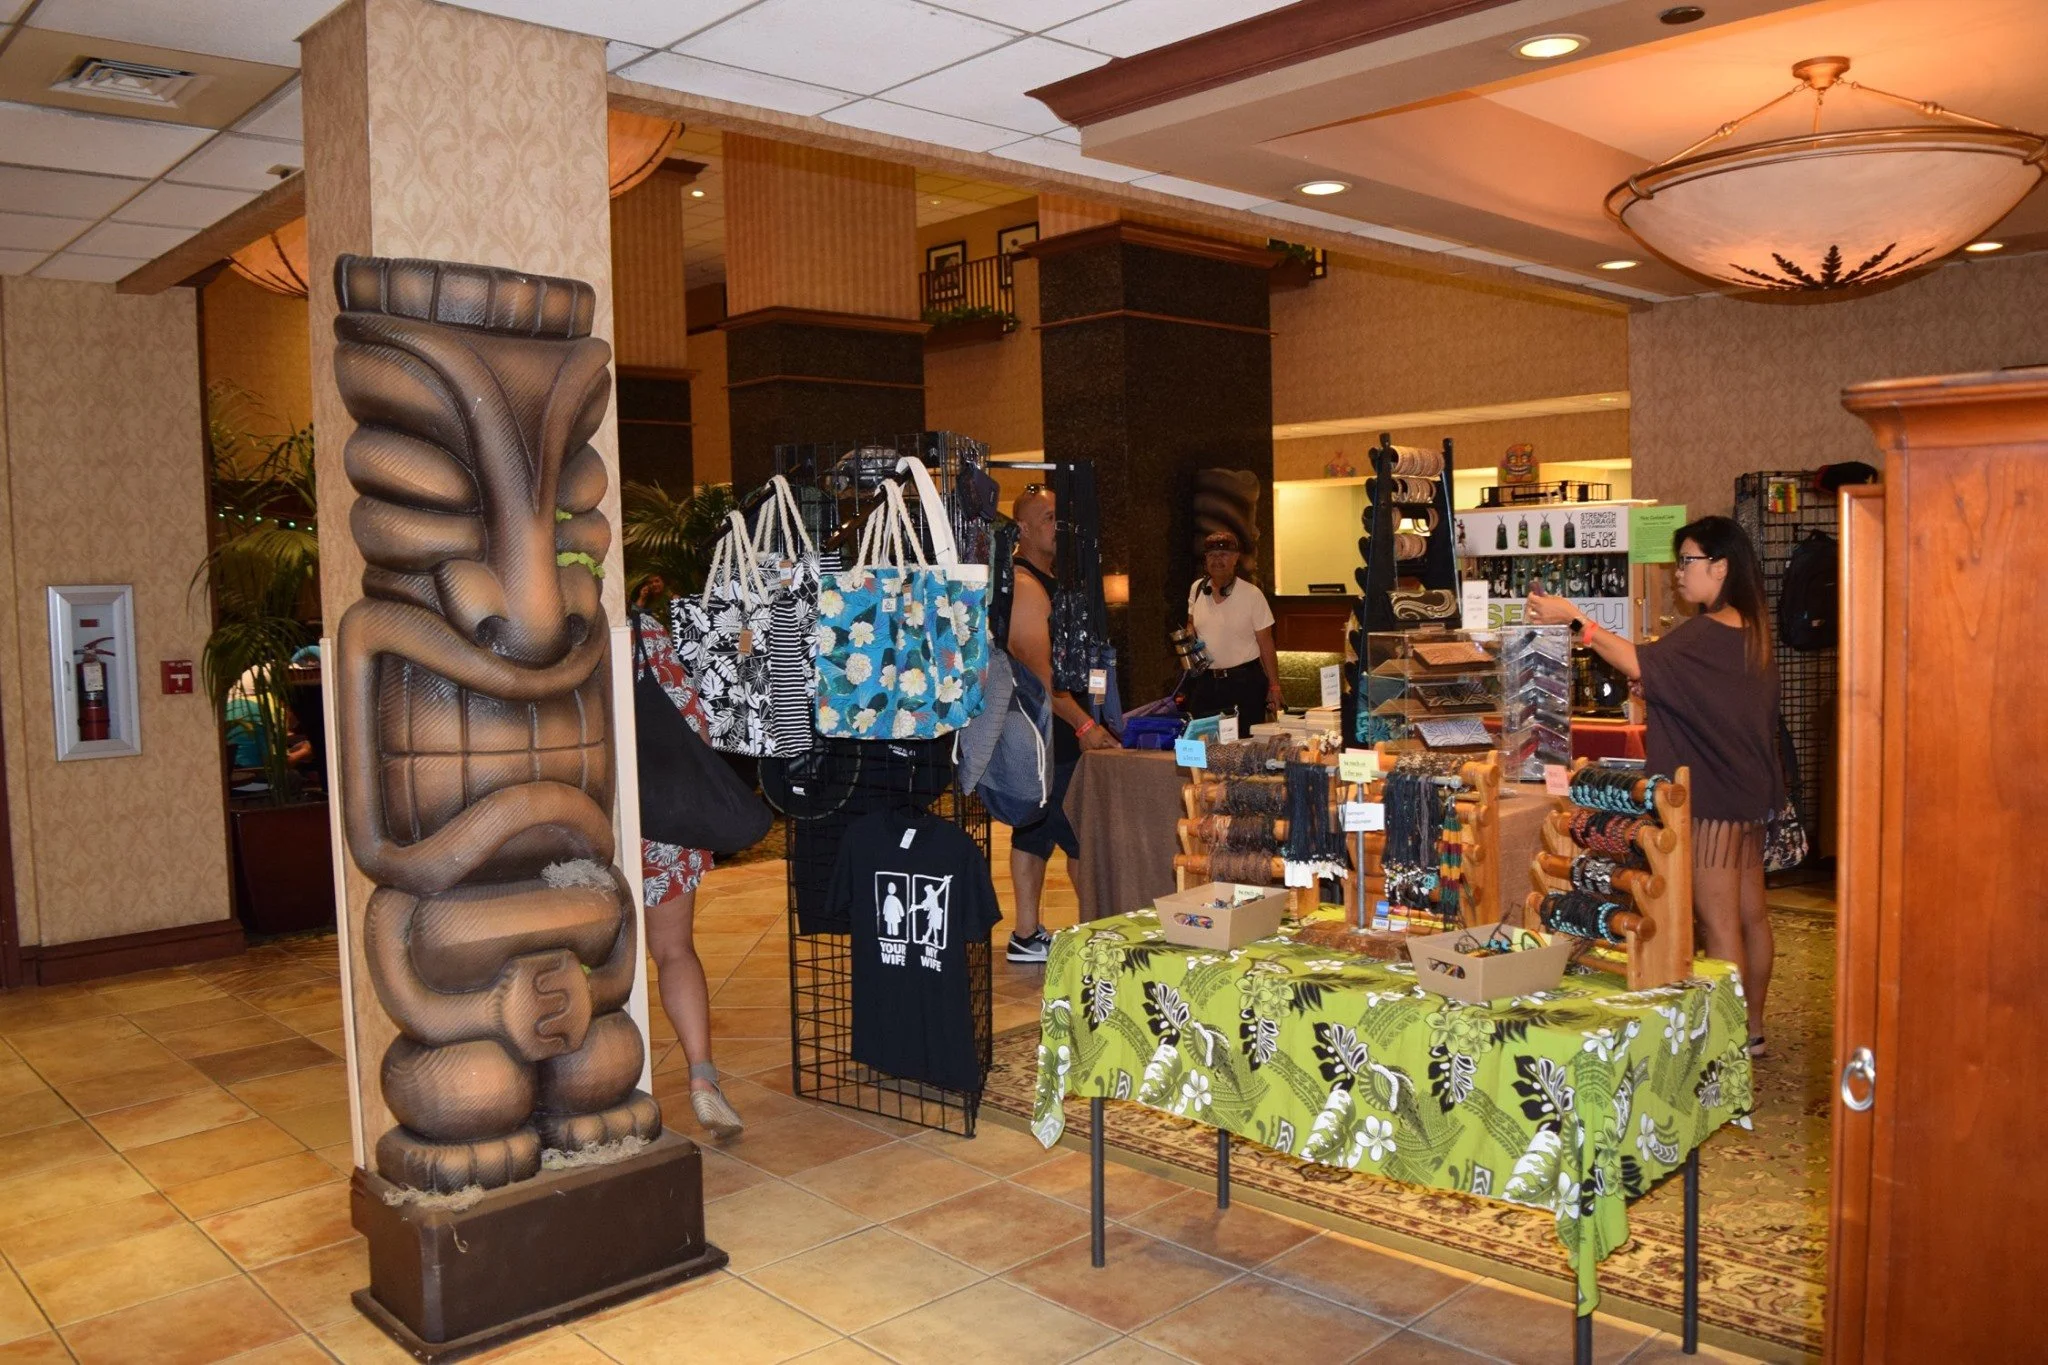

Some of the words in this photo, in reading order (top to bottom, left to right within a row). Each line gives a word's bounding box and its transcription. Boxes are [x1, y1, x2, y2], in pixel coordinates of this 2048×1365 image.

[1598, 531, 1617, 539] TOKI
[1581, 538, 1617, 548] BLADE
[880, 942, 907, 955] YOUR
[925, 946, 939, 959] MY
[881, 953, 906, 966] WIFE
[920, 956, 942, 972] WIFE
